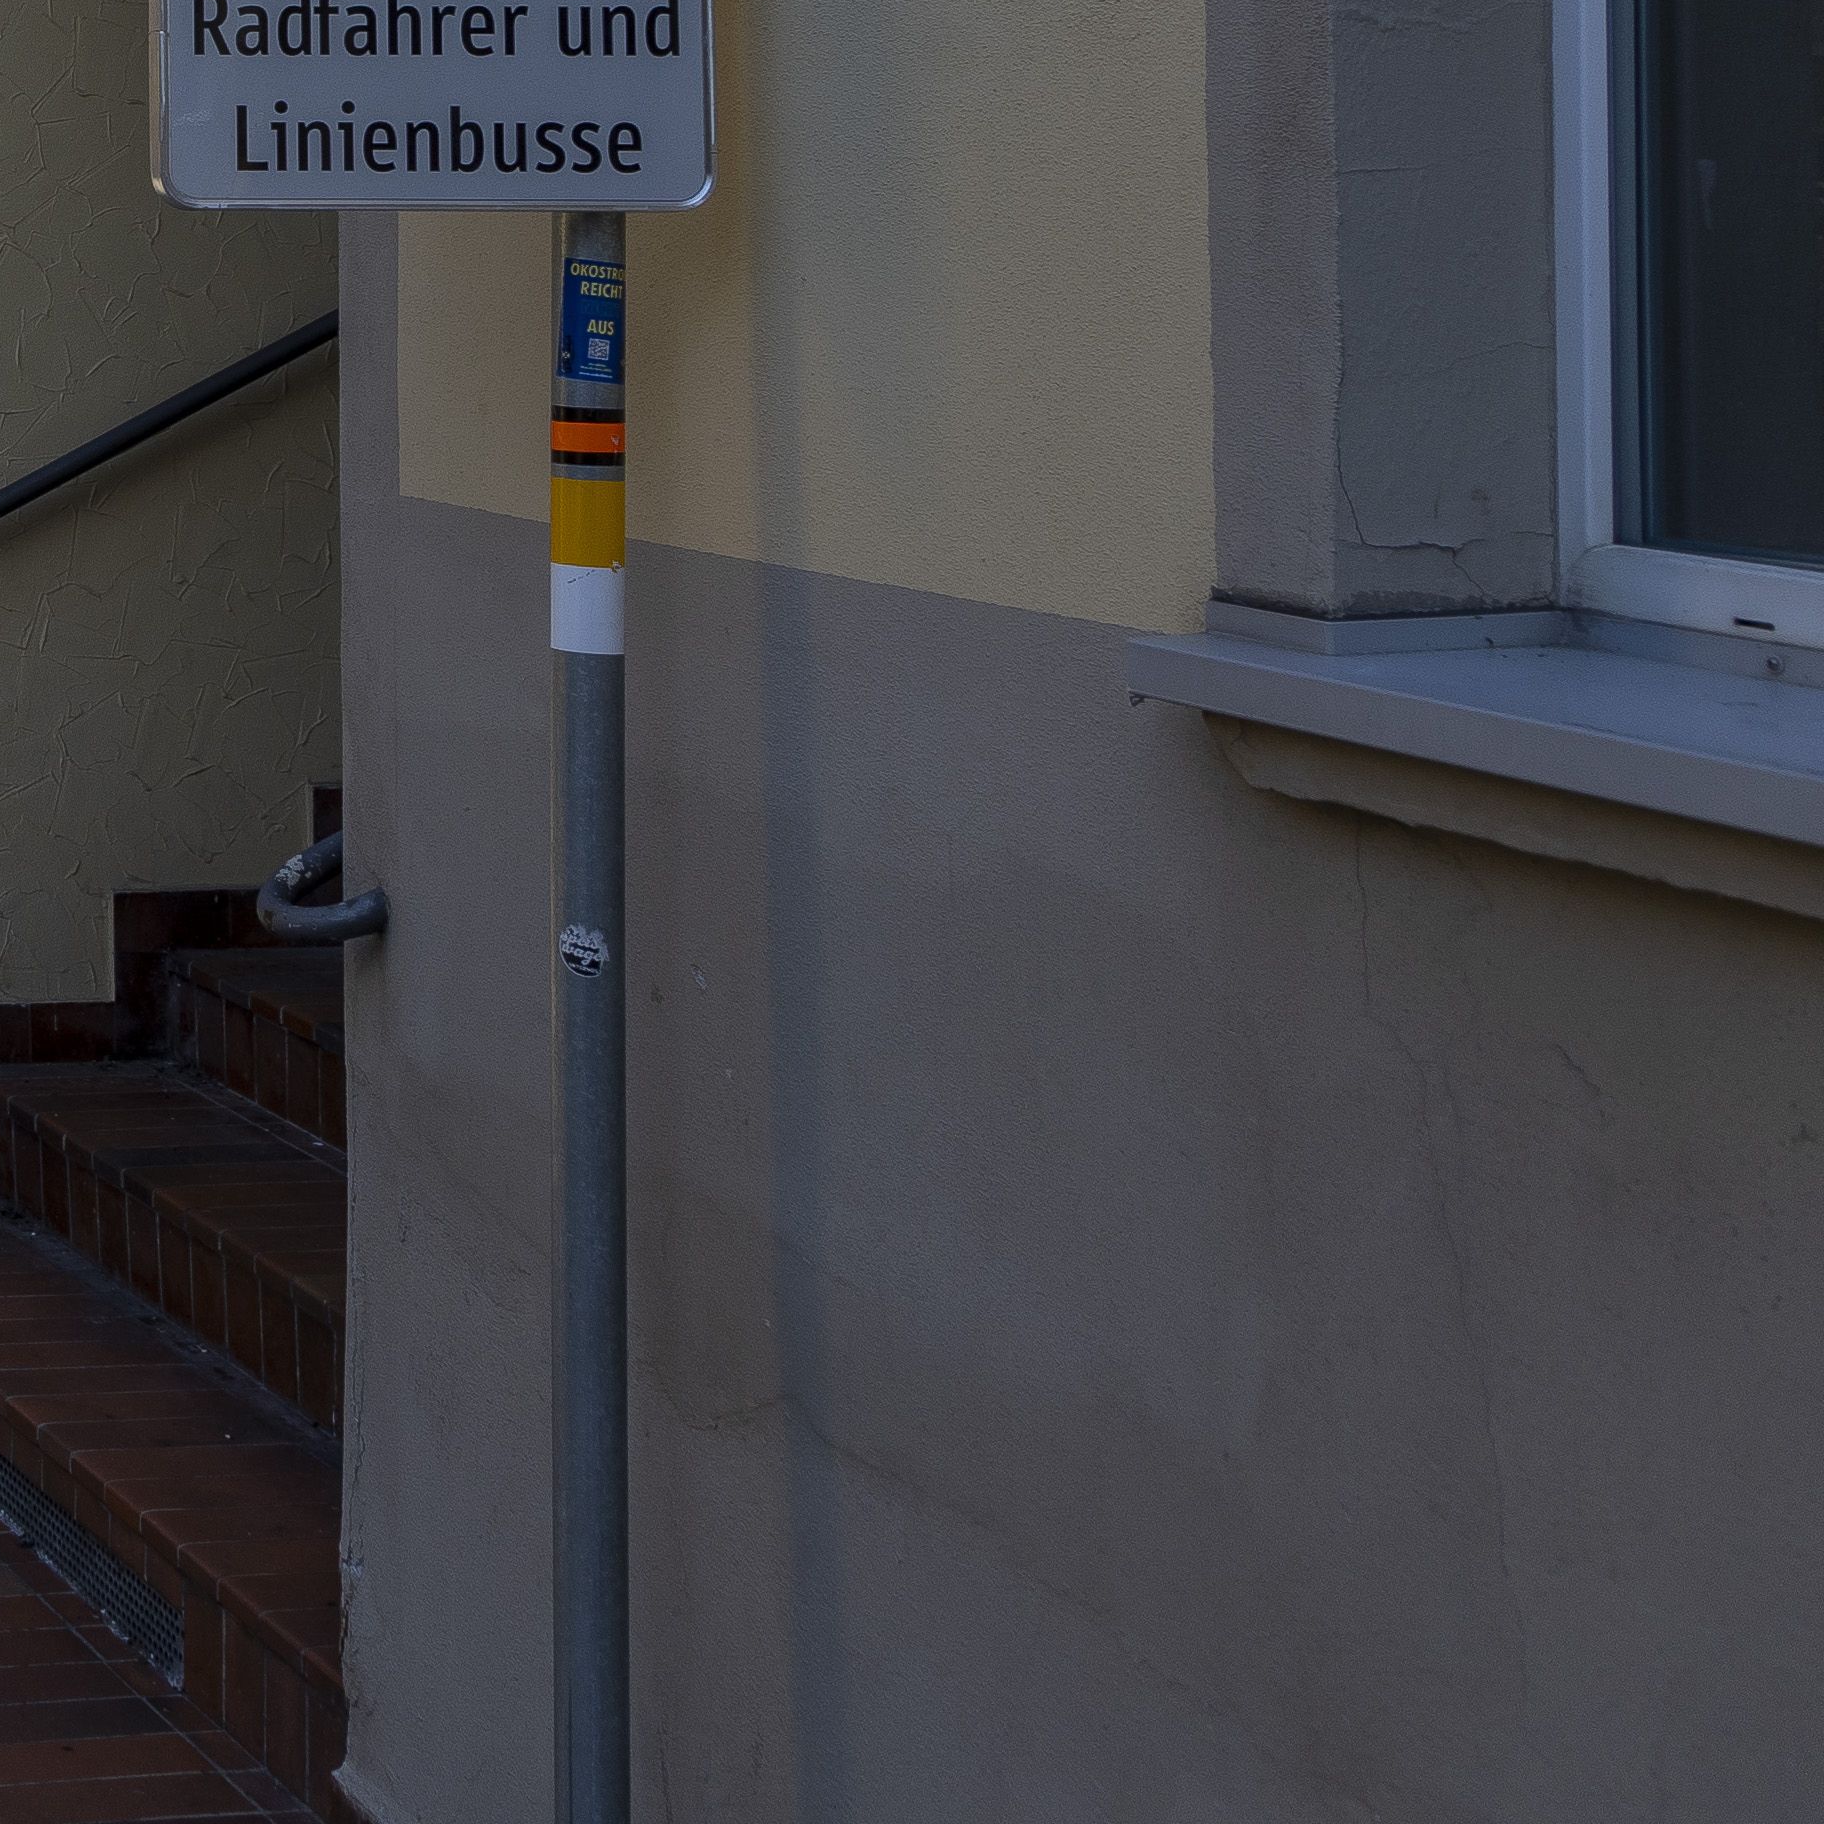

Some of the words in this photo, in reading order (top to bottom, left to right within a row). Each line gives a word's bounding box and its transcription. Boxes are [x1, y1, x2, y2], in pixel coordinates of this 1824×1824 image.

[235, 99, 644, 174] Linienbusse
[580, 281, 623, 299] REICHT
[587, 319, 615, 335] AUS
